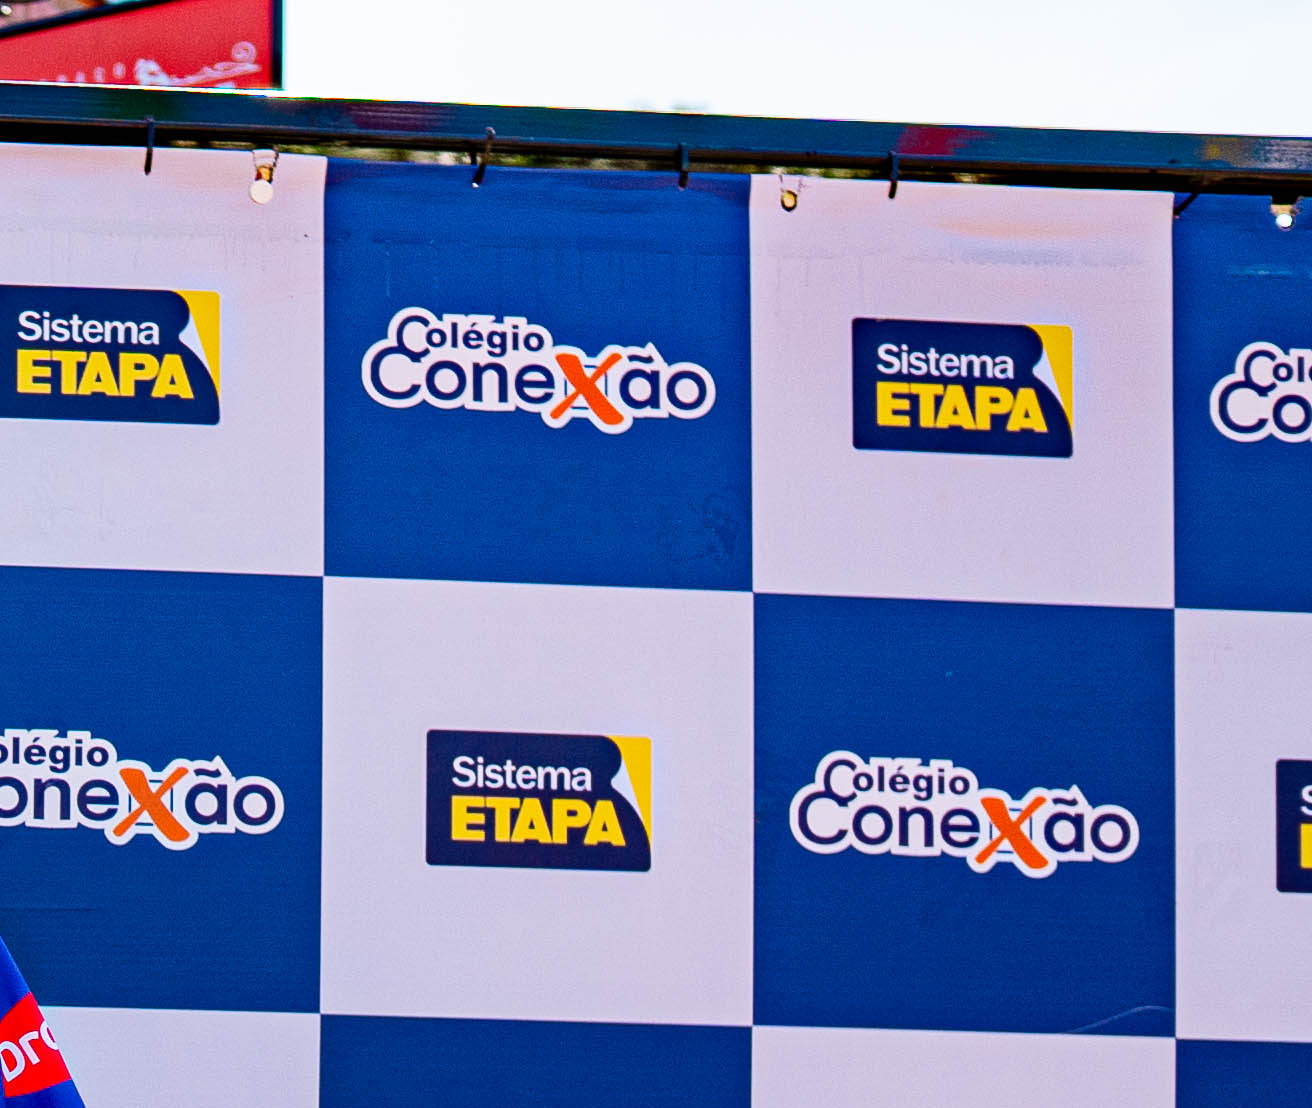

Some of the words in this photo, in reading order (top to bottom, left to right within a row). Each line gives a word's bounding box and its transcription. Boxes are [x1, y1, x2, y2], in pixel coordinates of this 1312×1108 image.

[19, 311, 160, 346] Sistema
[395, 313, 545, 353] Colégio
[16, 348, 194, 400] ETAPA
[876, 344, 1014, 379] Sistema
[876, 381, 1049, 434] ETAPA
[453, 756, 592, 791] Sistema
[824, 757, 971, 798] Colégio
[451, 795, 625, 846] ETAPA
